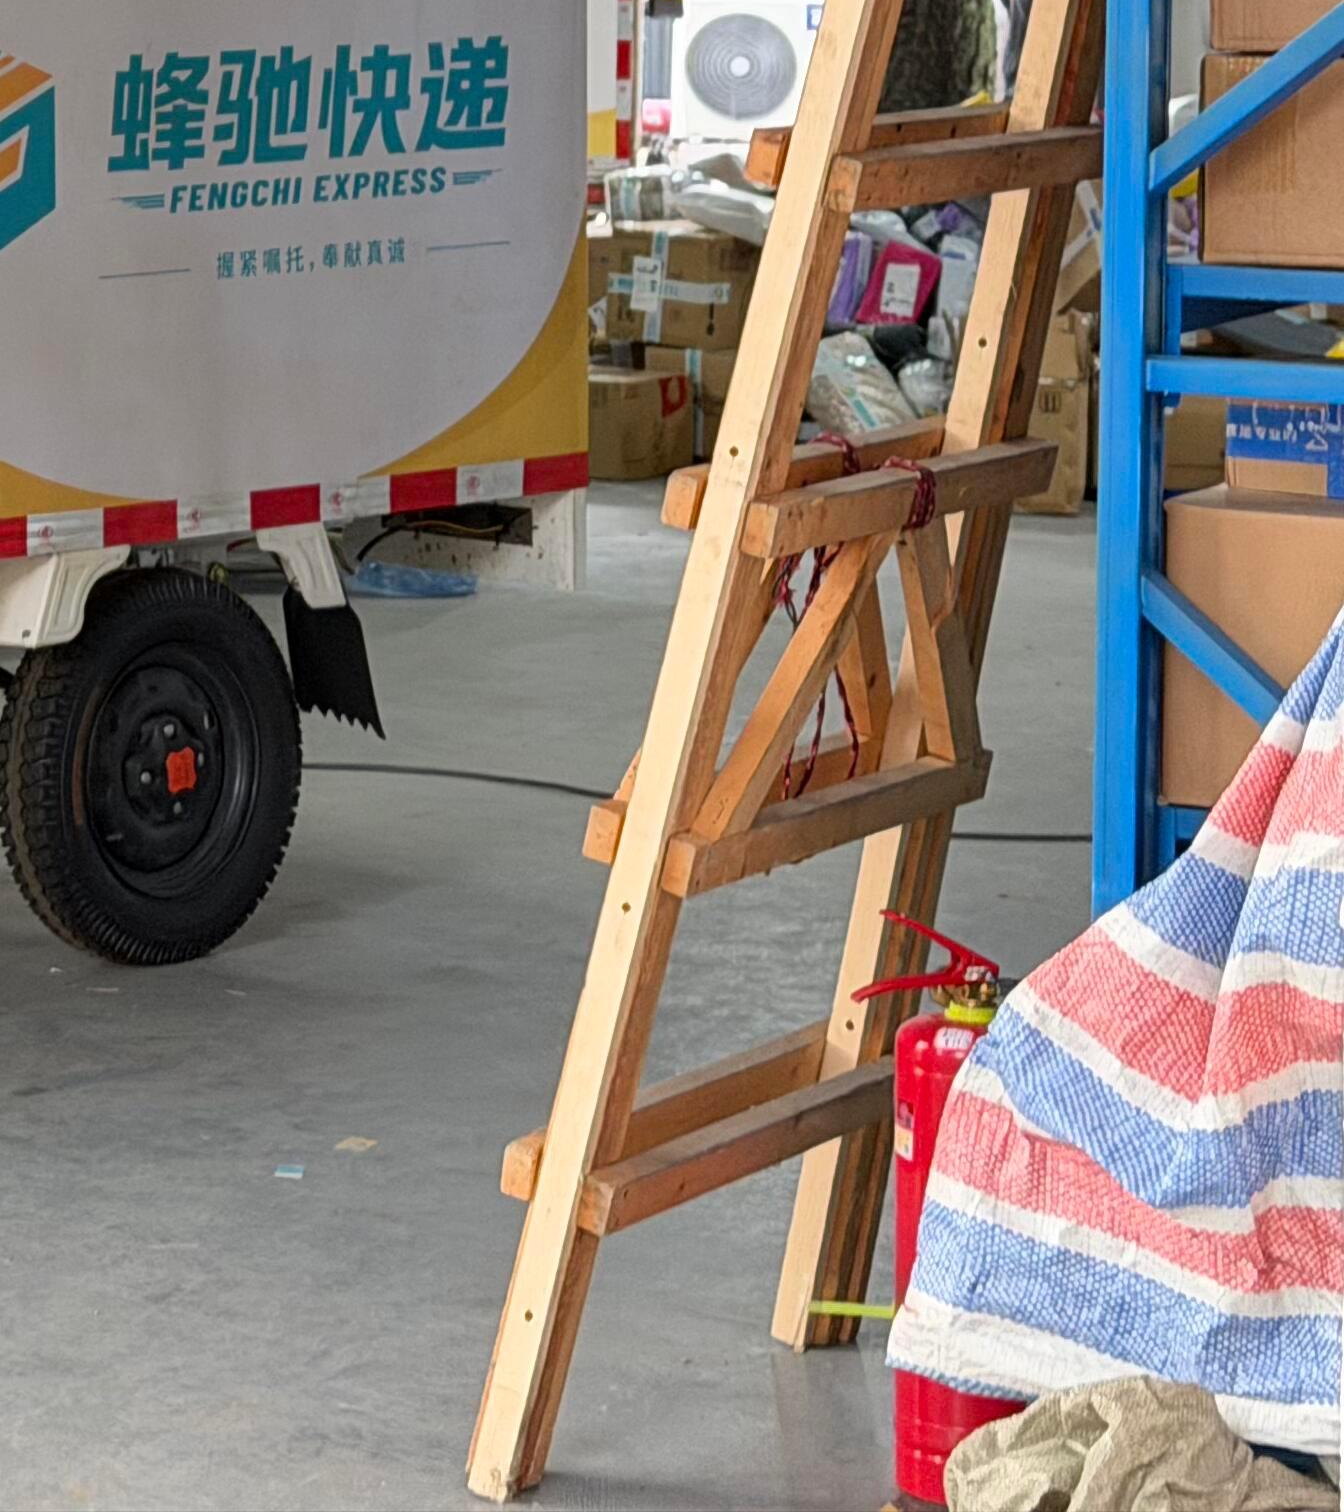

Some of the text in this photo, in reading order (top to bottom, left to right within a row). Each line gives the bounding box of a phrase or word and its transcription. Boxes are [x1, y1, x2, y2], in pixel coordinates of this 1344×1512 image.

[107, 35, 509, 173] 蜂驰快递
[169, 166, 446, 214] FENGCHI EXPRESS
